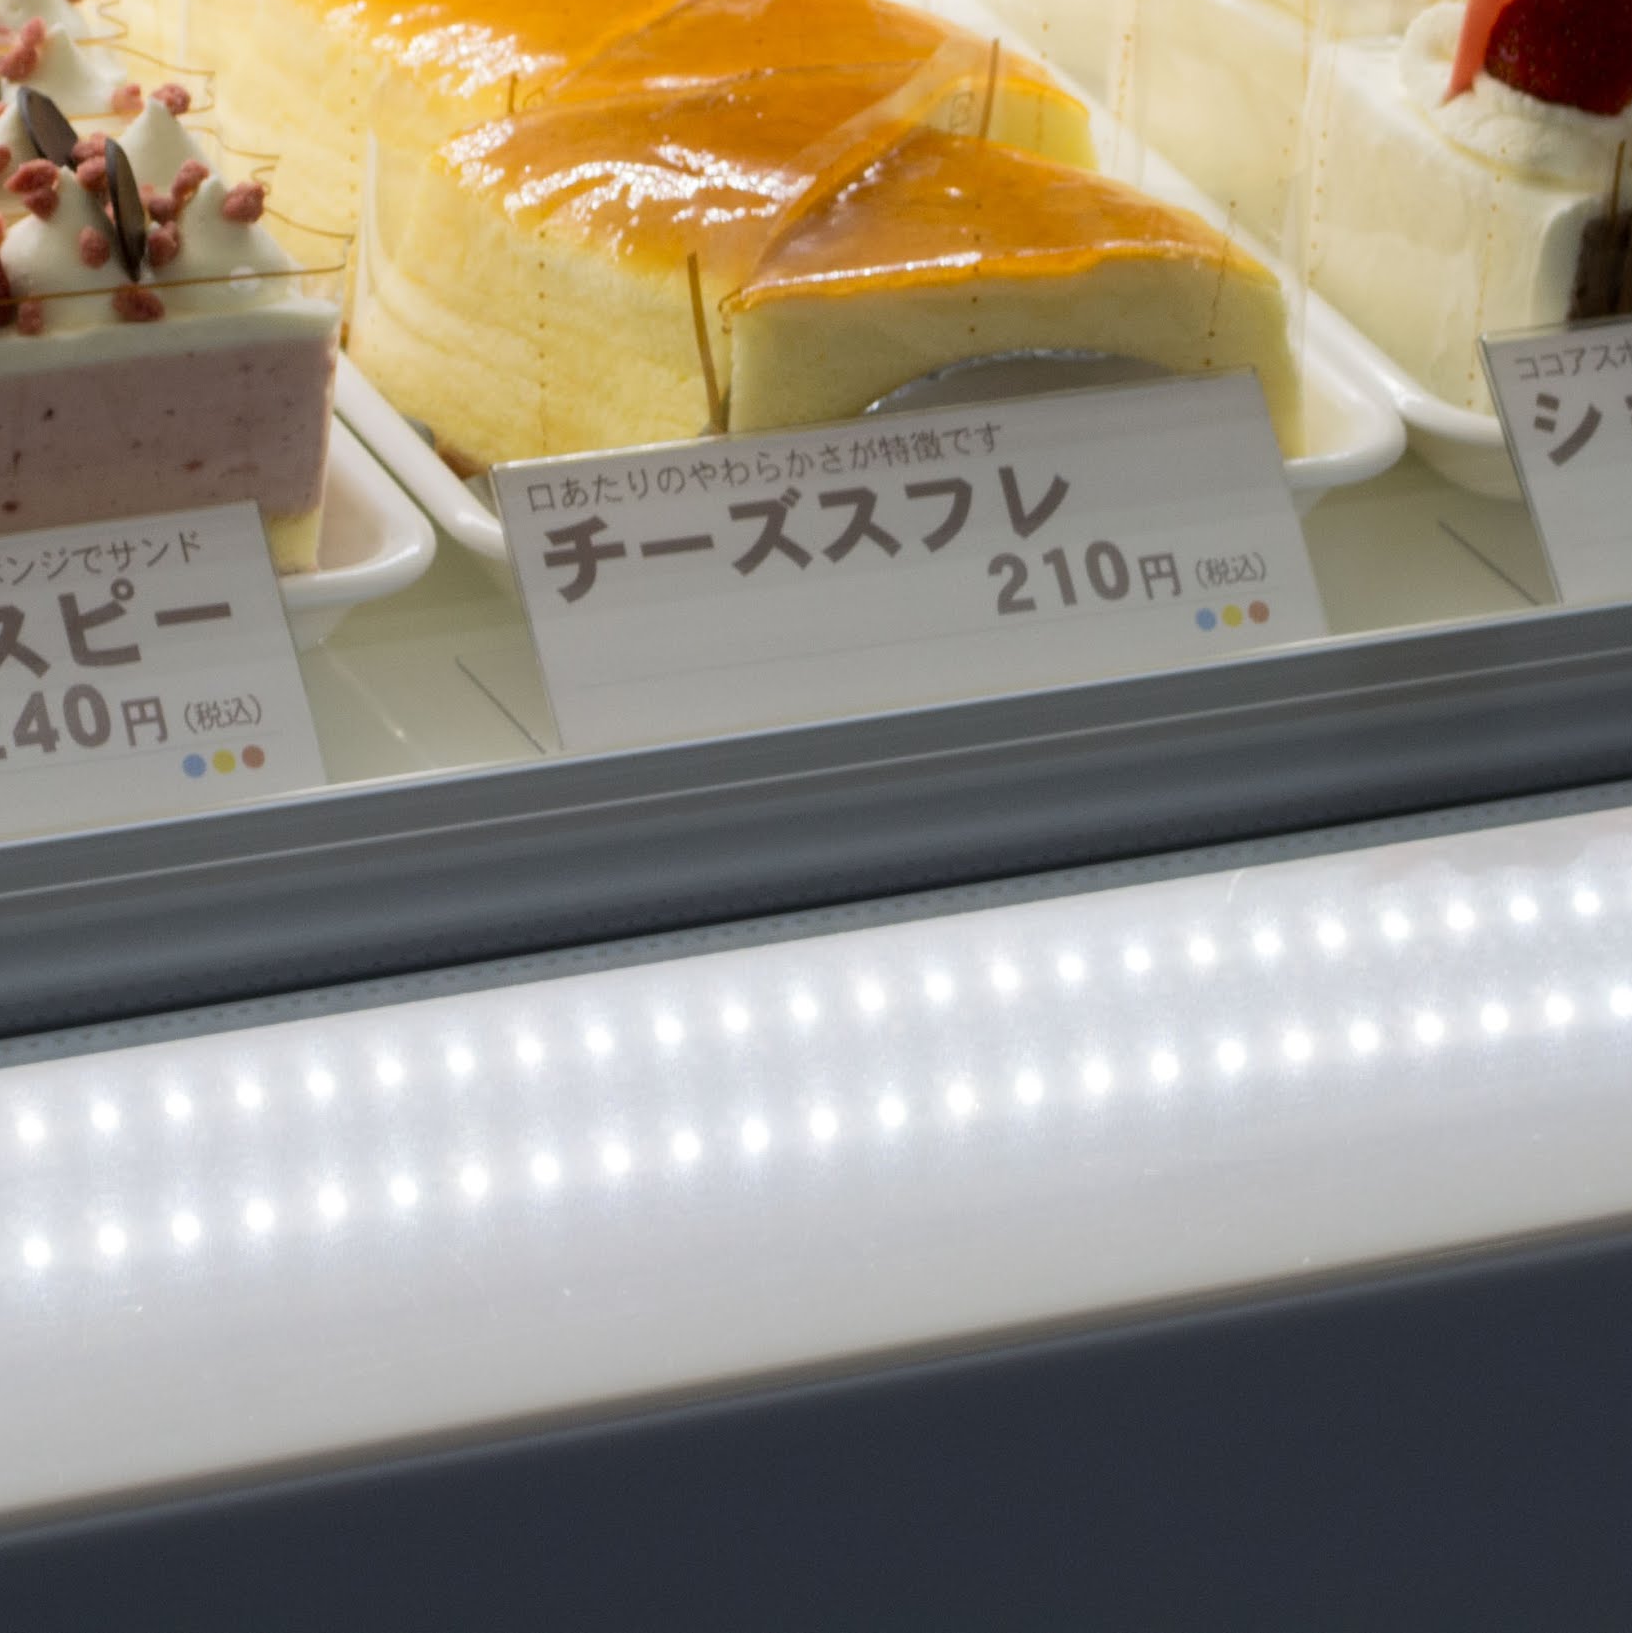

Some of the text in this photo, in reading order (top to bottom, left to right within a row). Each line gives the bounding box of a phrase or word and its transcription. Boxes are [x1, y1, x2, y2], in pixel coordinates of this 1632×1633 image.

[527, 423, 1002, 513] 口あたりのやわらかさが特徴です
[543, 465, 1070, 603] チーズスフレ
[988, 540, 1182, 615] 210円
